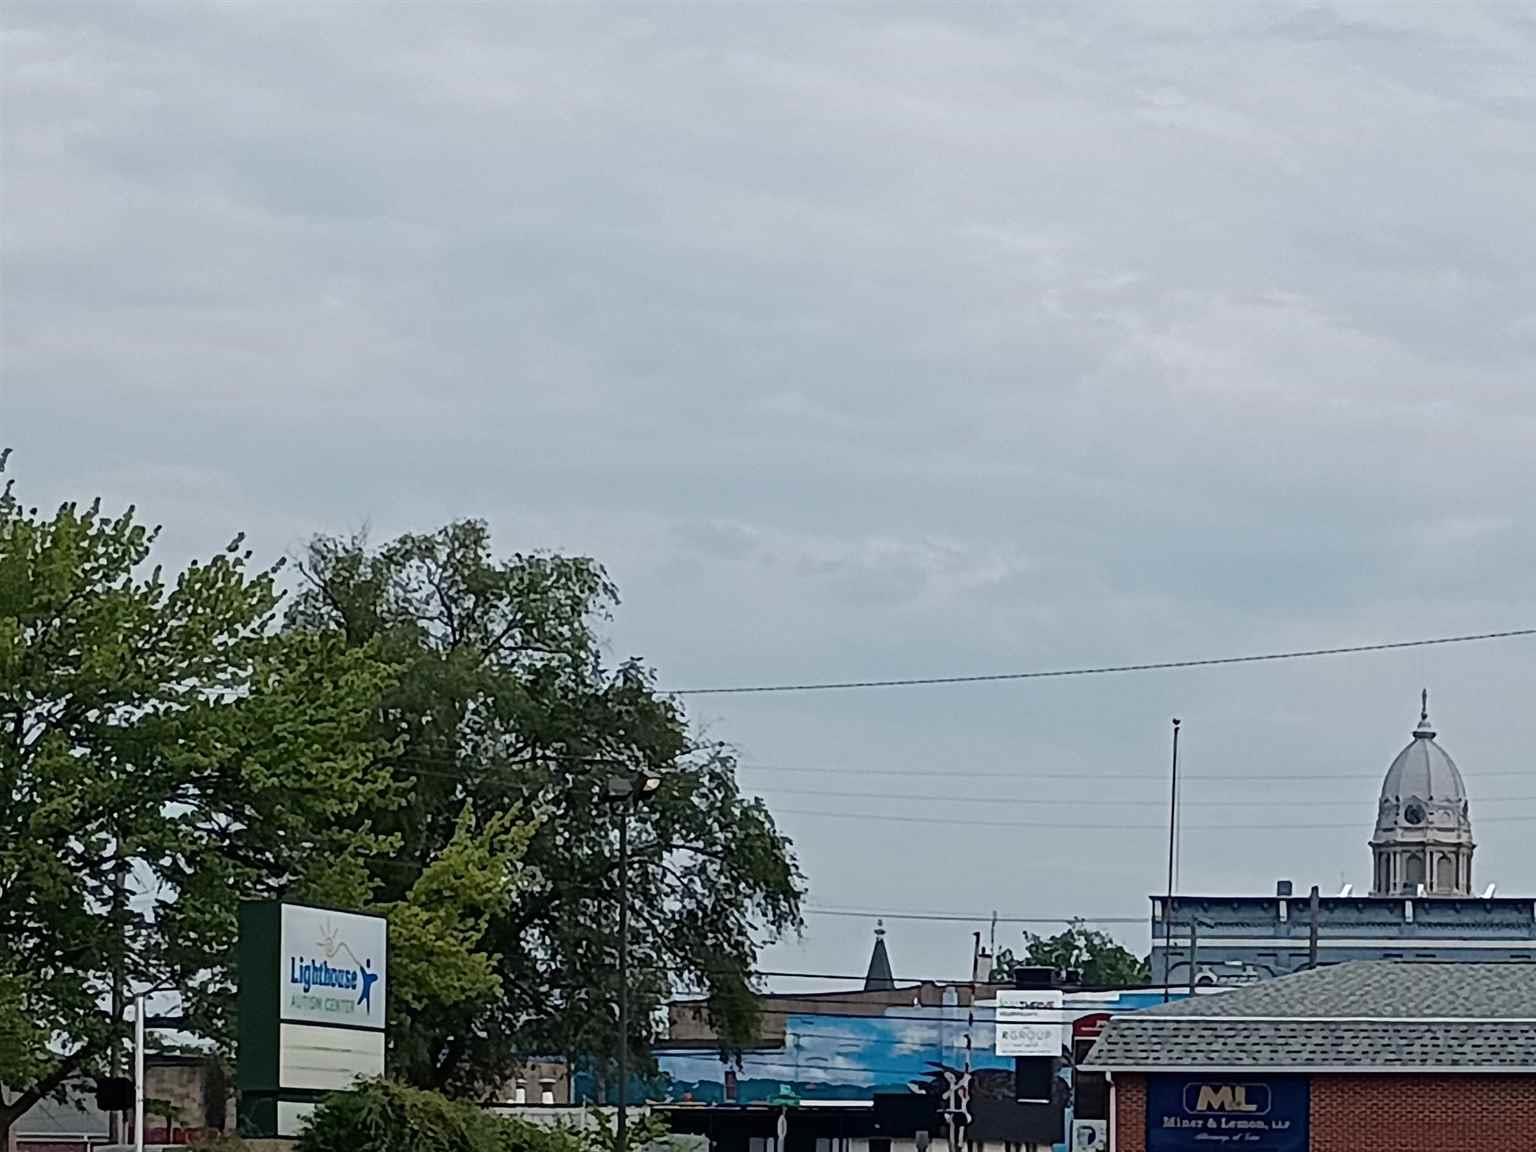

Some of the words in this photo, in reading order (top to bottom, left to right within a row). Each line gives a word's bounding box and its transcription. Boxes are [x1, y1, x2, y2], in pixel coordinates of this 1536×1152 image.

[290, 956, 358, 993] Lighthouse
[325, 997, 356, 1014] CENTER
[1162, 1116, 1204, 1128] Miner
[1206, 1117, 1217, 1128] &
